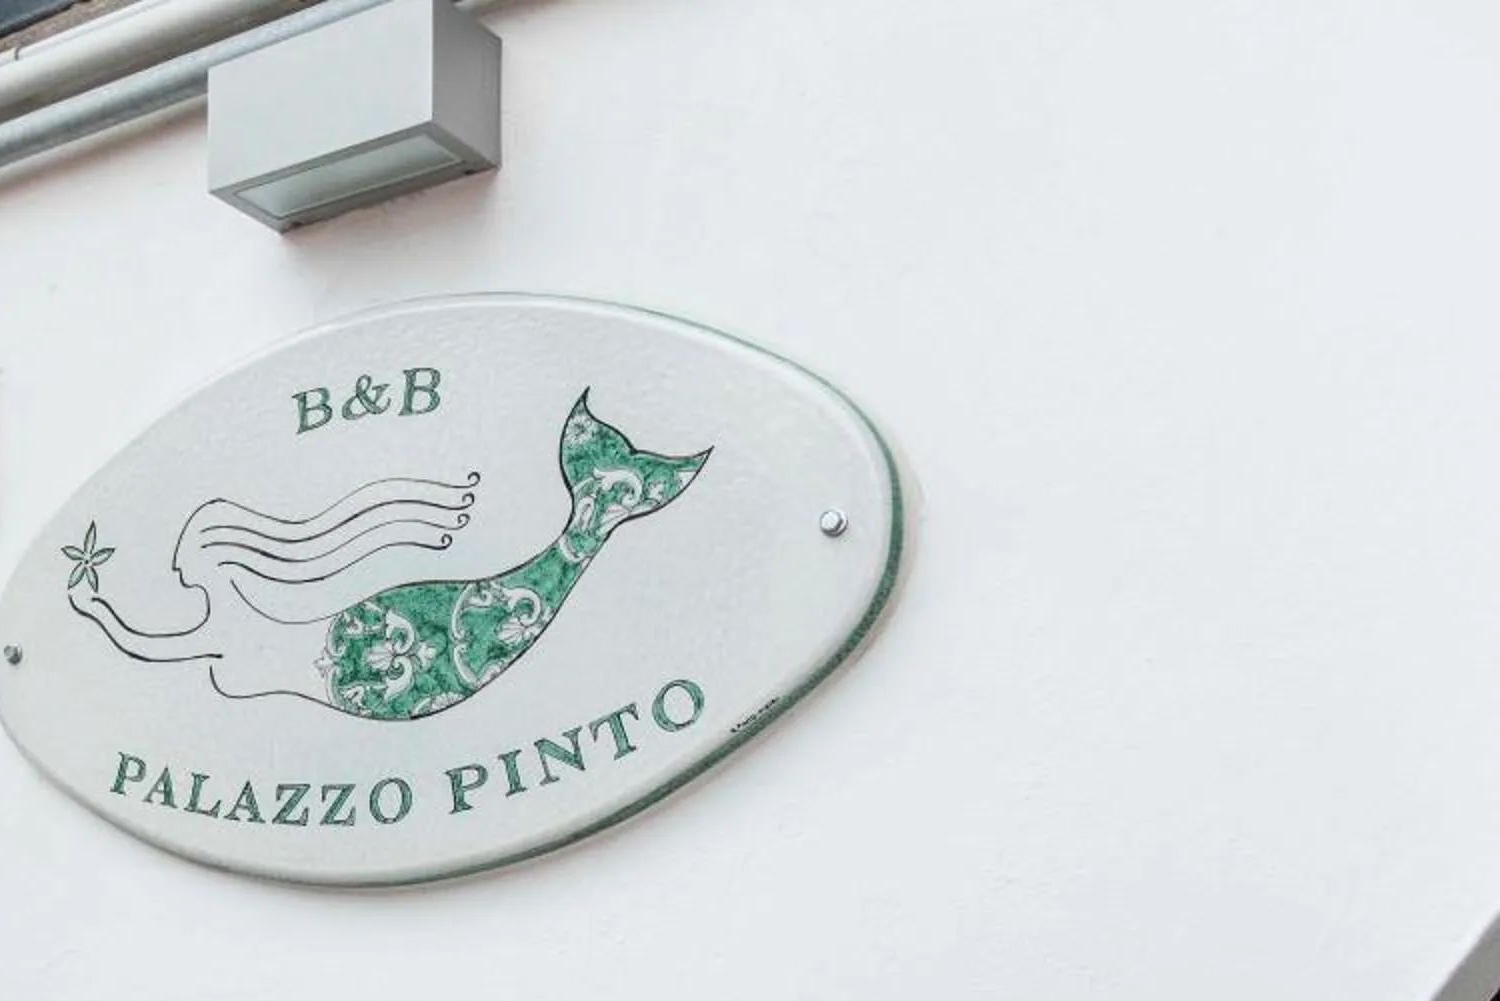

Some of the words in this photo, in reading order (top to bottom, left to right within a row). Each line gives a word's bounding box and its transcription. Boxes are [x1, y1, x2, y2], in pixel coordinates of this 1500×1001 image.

[292, 368, 441, 435] B&B
[110, 751, 413, 826] PALAZZO
[445, 679, 704, 814] PINTO
